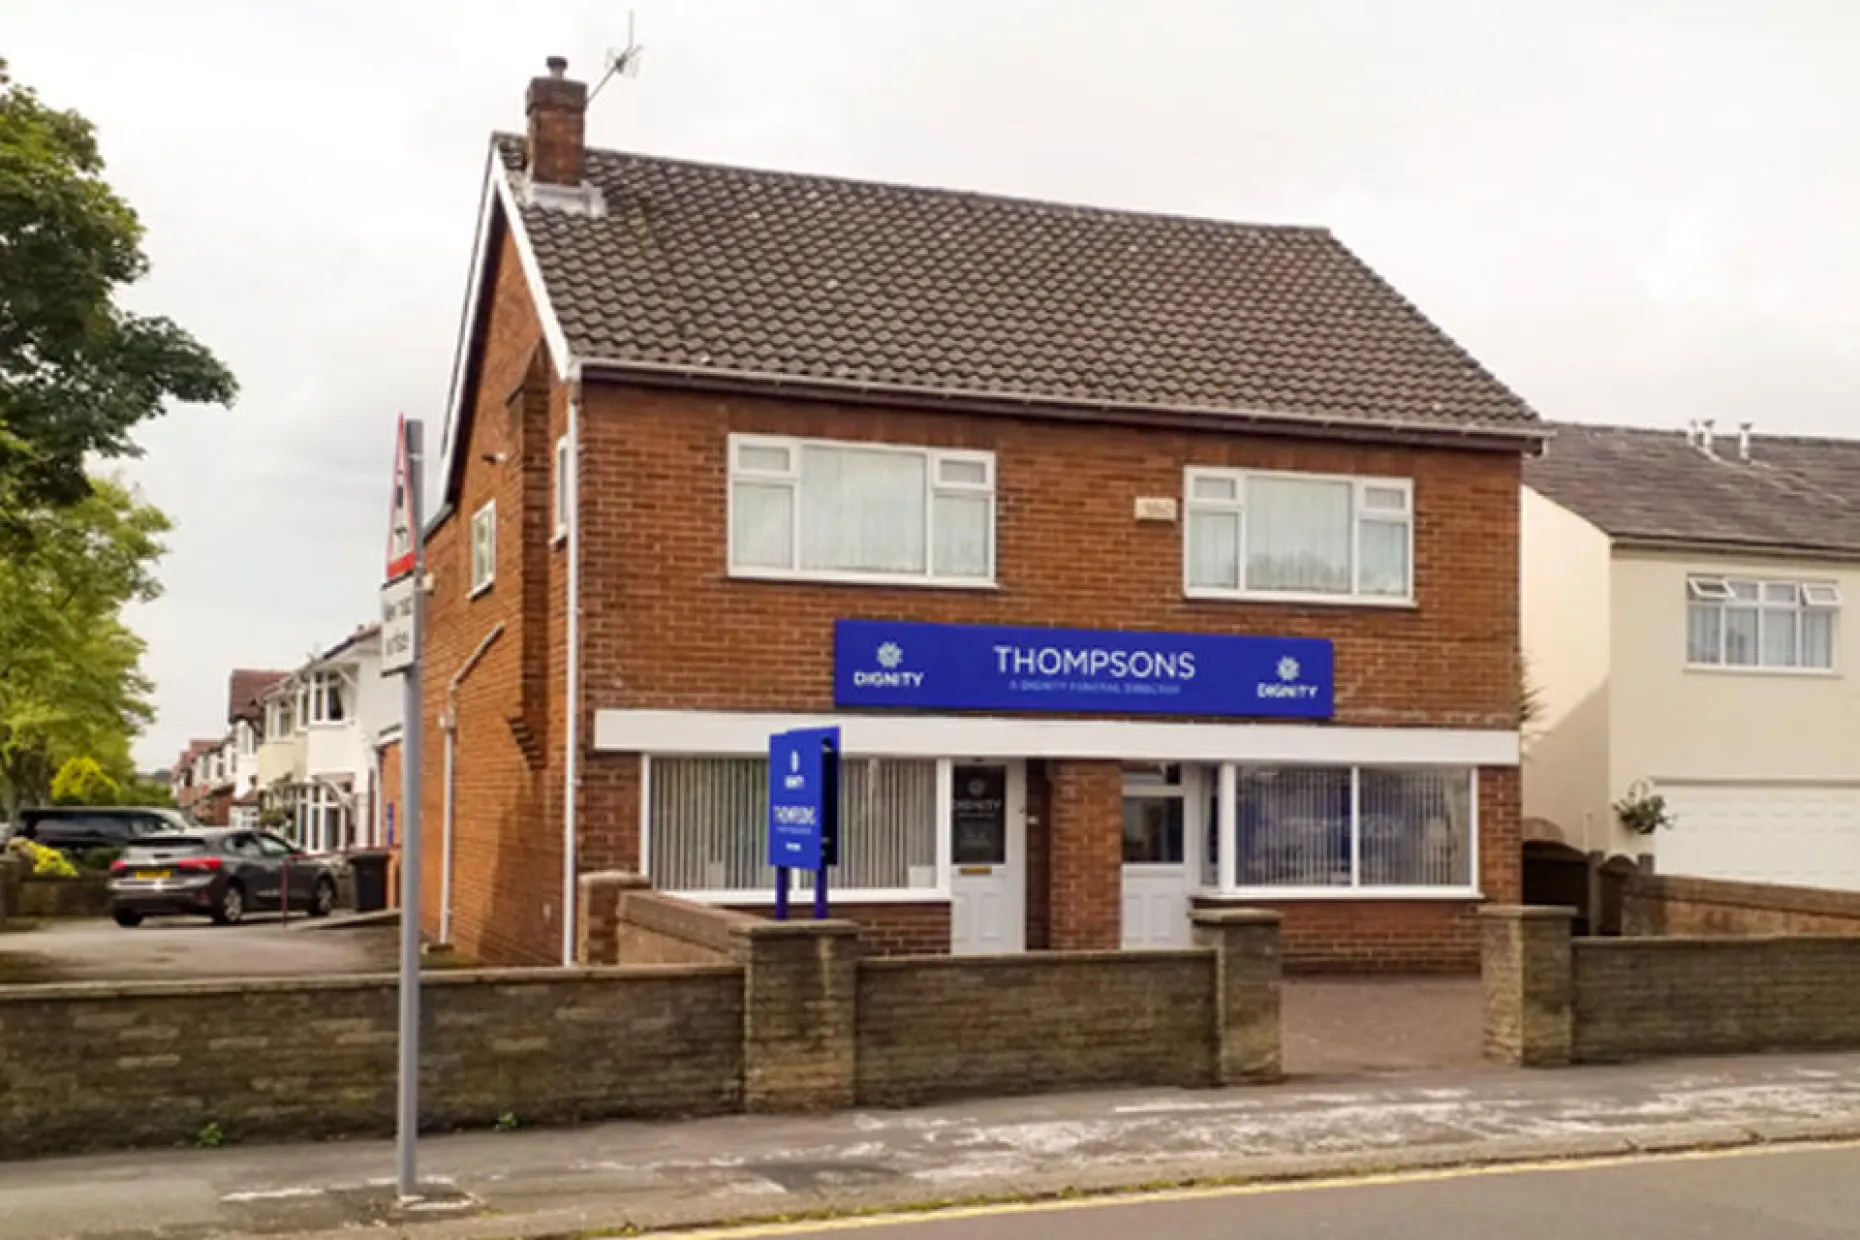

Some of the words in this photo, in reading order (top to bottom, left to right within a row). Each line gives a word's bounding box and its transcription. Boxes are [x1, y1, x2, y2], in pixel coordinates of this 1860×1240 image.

[993, 644, 1196, 679] THOMPSONS
[853, 671, 925, 688] DIGNITY
[1256, 682, 1319, 699] DIGNITY
